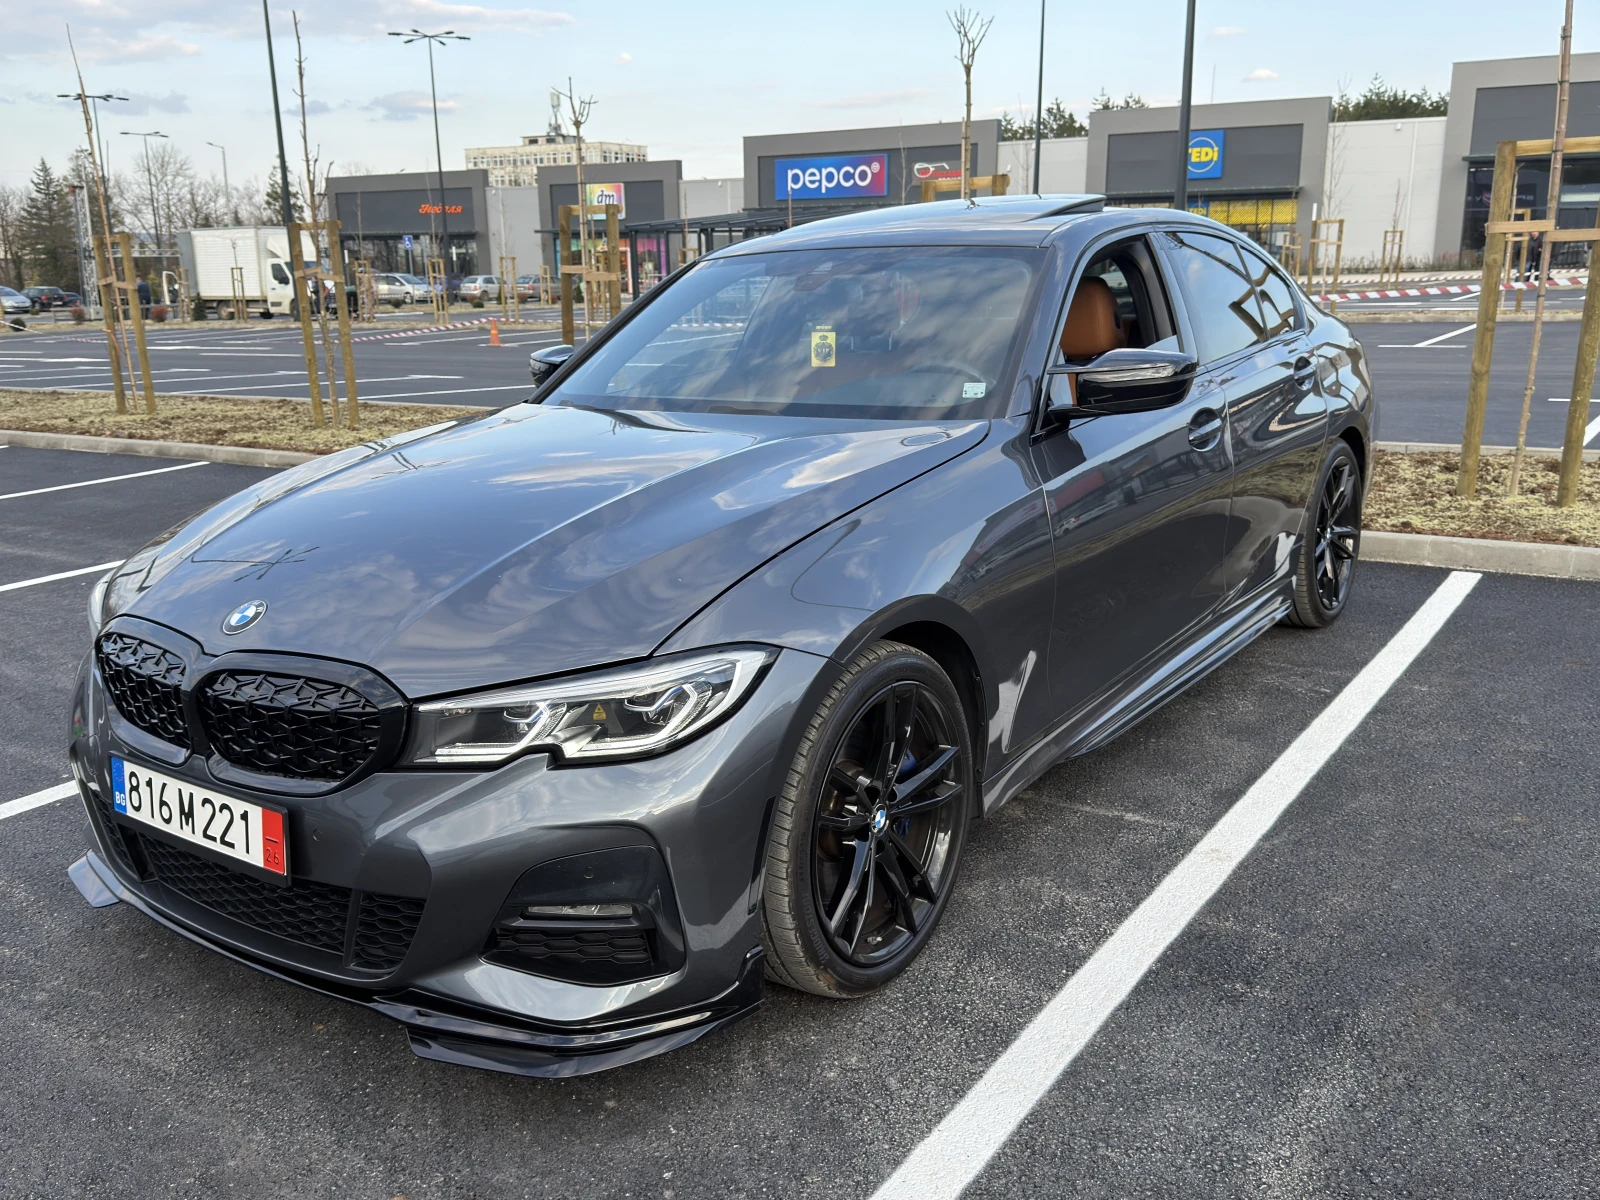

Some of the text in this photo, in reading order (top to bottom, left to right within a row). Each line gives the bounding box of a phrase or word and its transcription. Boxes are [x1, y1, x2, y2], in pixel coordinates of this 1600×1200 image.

[787, 165, 872, 194] pepco
[597, 189, 615, 205] dm
[115, 791, 126, 806] BG
[265, 848, 280, 865] 26
